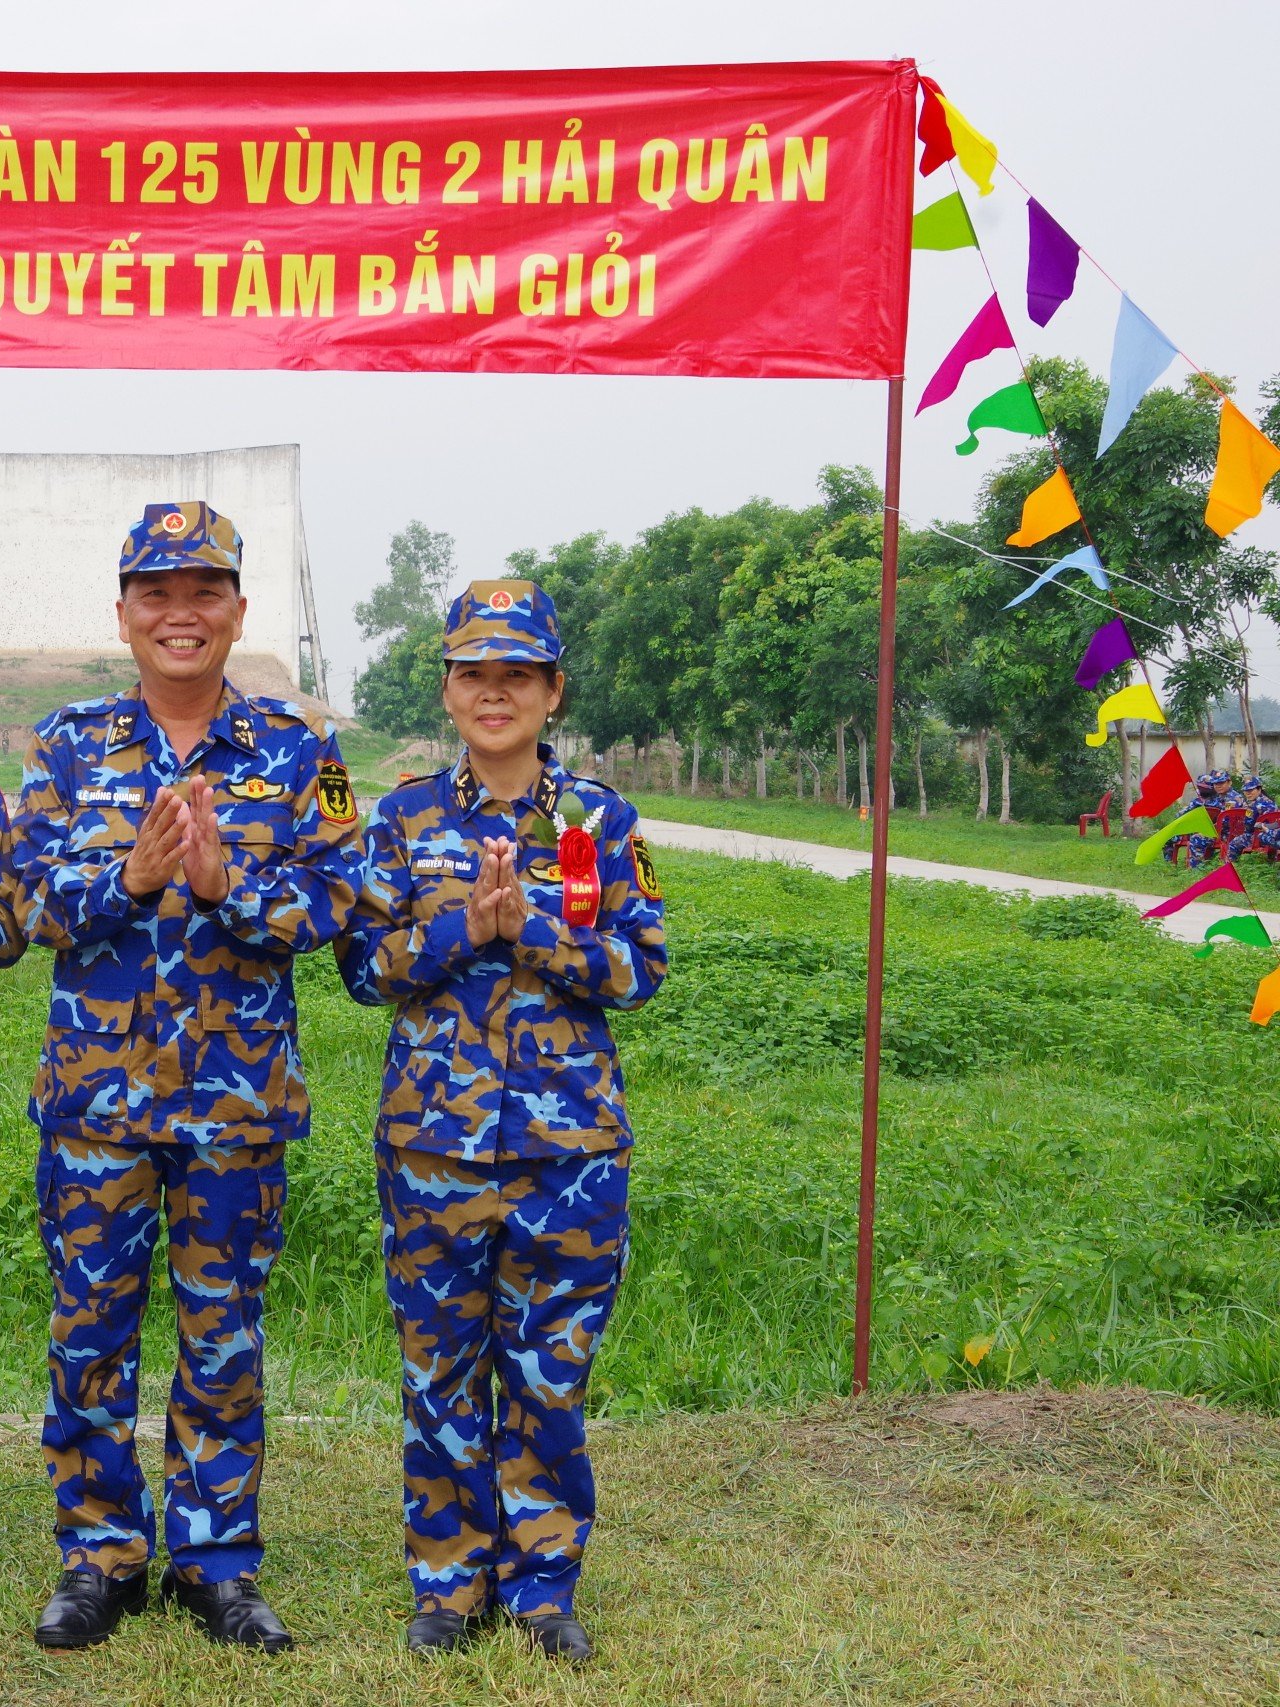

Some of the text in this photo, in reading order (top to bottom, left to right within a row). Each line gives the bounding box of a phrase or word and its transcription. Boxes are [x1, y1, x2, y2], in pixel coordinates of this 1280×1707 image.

[102, 140, 218, 204] 125
[242, 126, 420, 205] VÙNG
[442, 140, 480, 204] 2
[503, 118, 615, 204] HẢI
[638, 123, 828, 212] QUÂN
[195, 239, 335, 318] TÂM
[359, 229, 496, 317] BẮN
[519, 231, 656, 318] GIỎI
